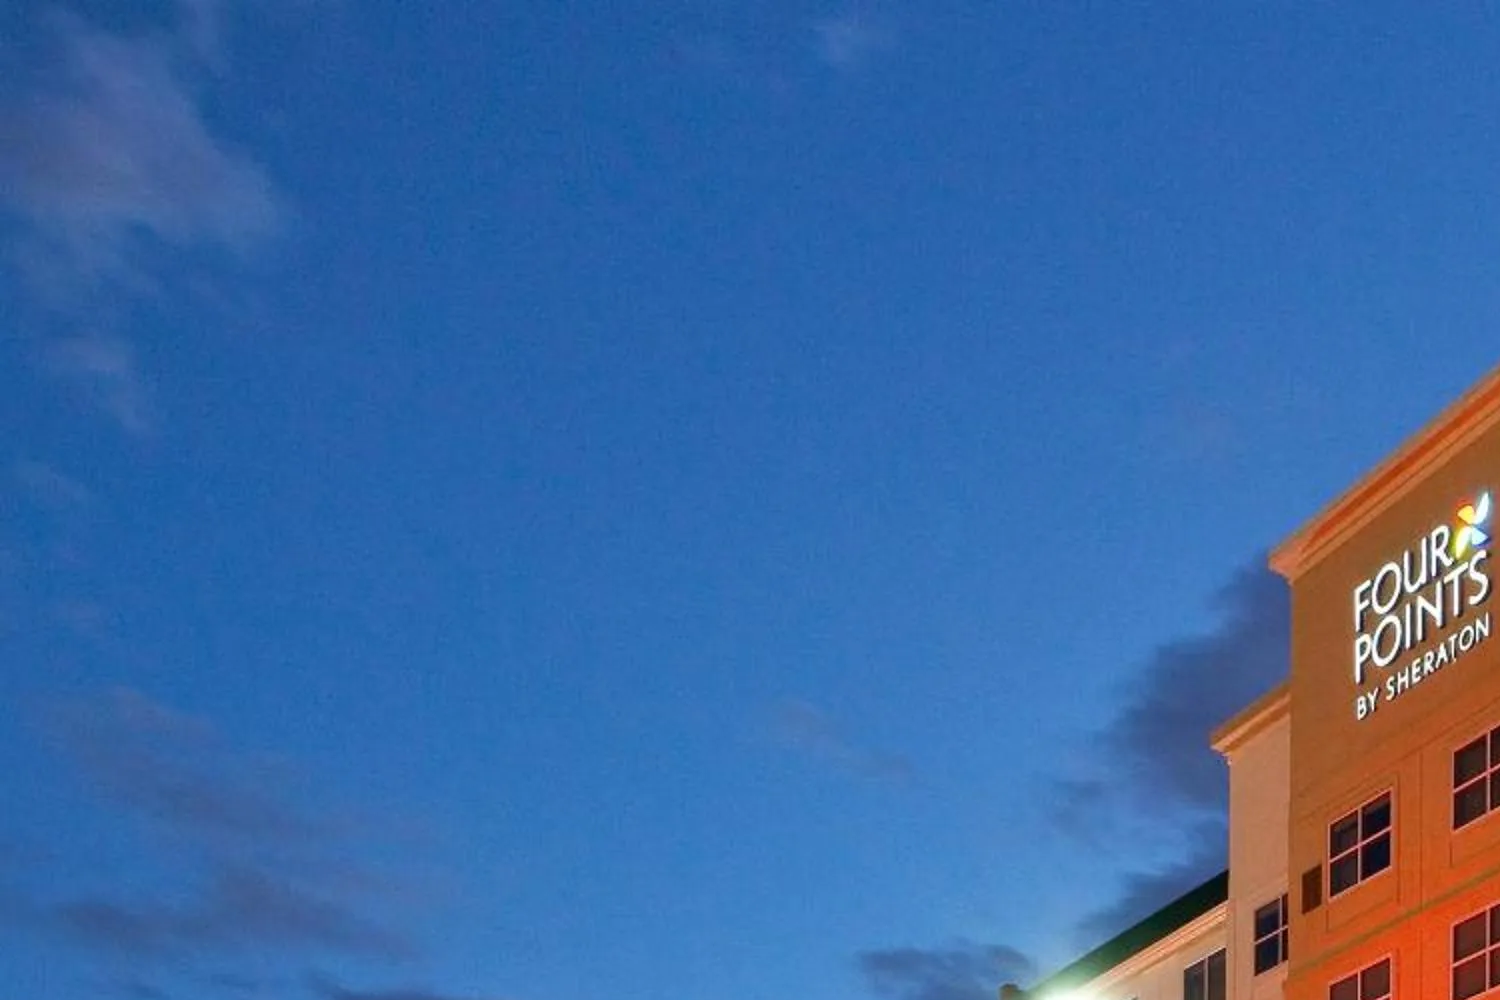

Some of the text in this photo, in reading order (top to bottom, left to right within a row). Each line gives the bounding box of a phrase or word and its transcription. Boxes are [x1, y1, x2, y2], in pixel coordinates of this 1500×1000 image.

[1354, 524, 1453, 632] FOUR
[1354, 551, 1489, 684] POINTS
[1356, 612, 1490, 720] BY SHERATON
